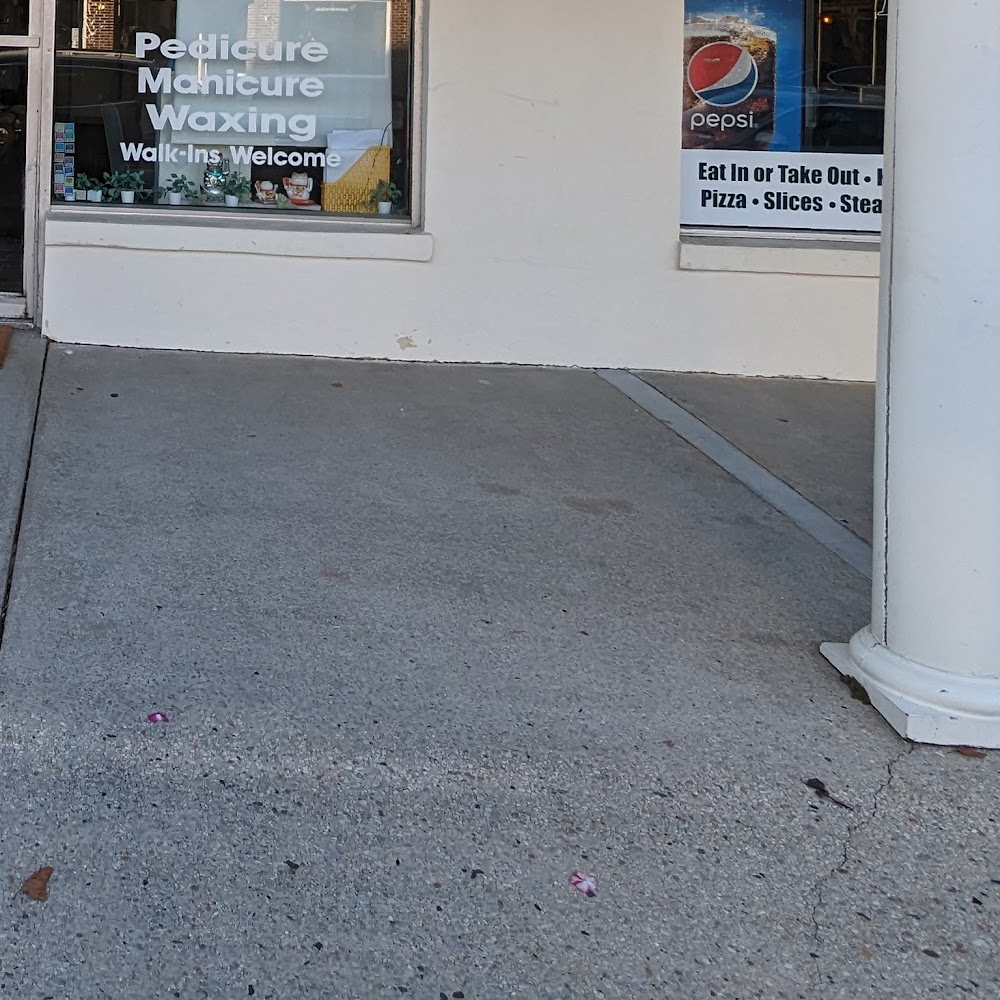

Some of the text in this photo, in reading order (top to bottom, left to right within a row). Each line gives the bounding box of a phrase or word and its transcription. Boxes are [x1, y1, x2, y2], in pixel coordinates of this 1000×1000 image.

[135, 32, 329, 62] Pedicure
[138, 66, 325, 98] Manicure
[145, 103, 317, 142] Waxing
[690, 111, 754, 132] pepsi
[119, 141, 342, 168] Walk-Ins Welcome
[698, 162, 727, 181] Eat
[731, 163, 749, 182] In
[754, 167, 774, 183] or
[778, 164, 823, 185] Take
[827, 166, 860, 186] Out
[701, 189, 883, 214] Pizza Slices Stea
